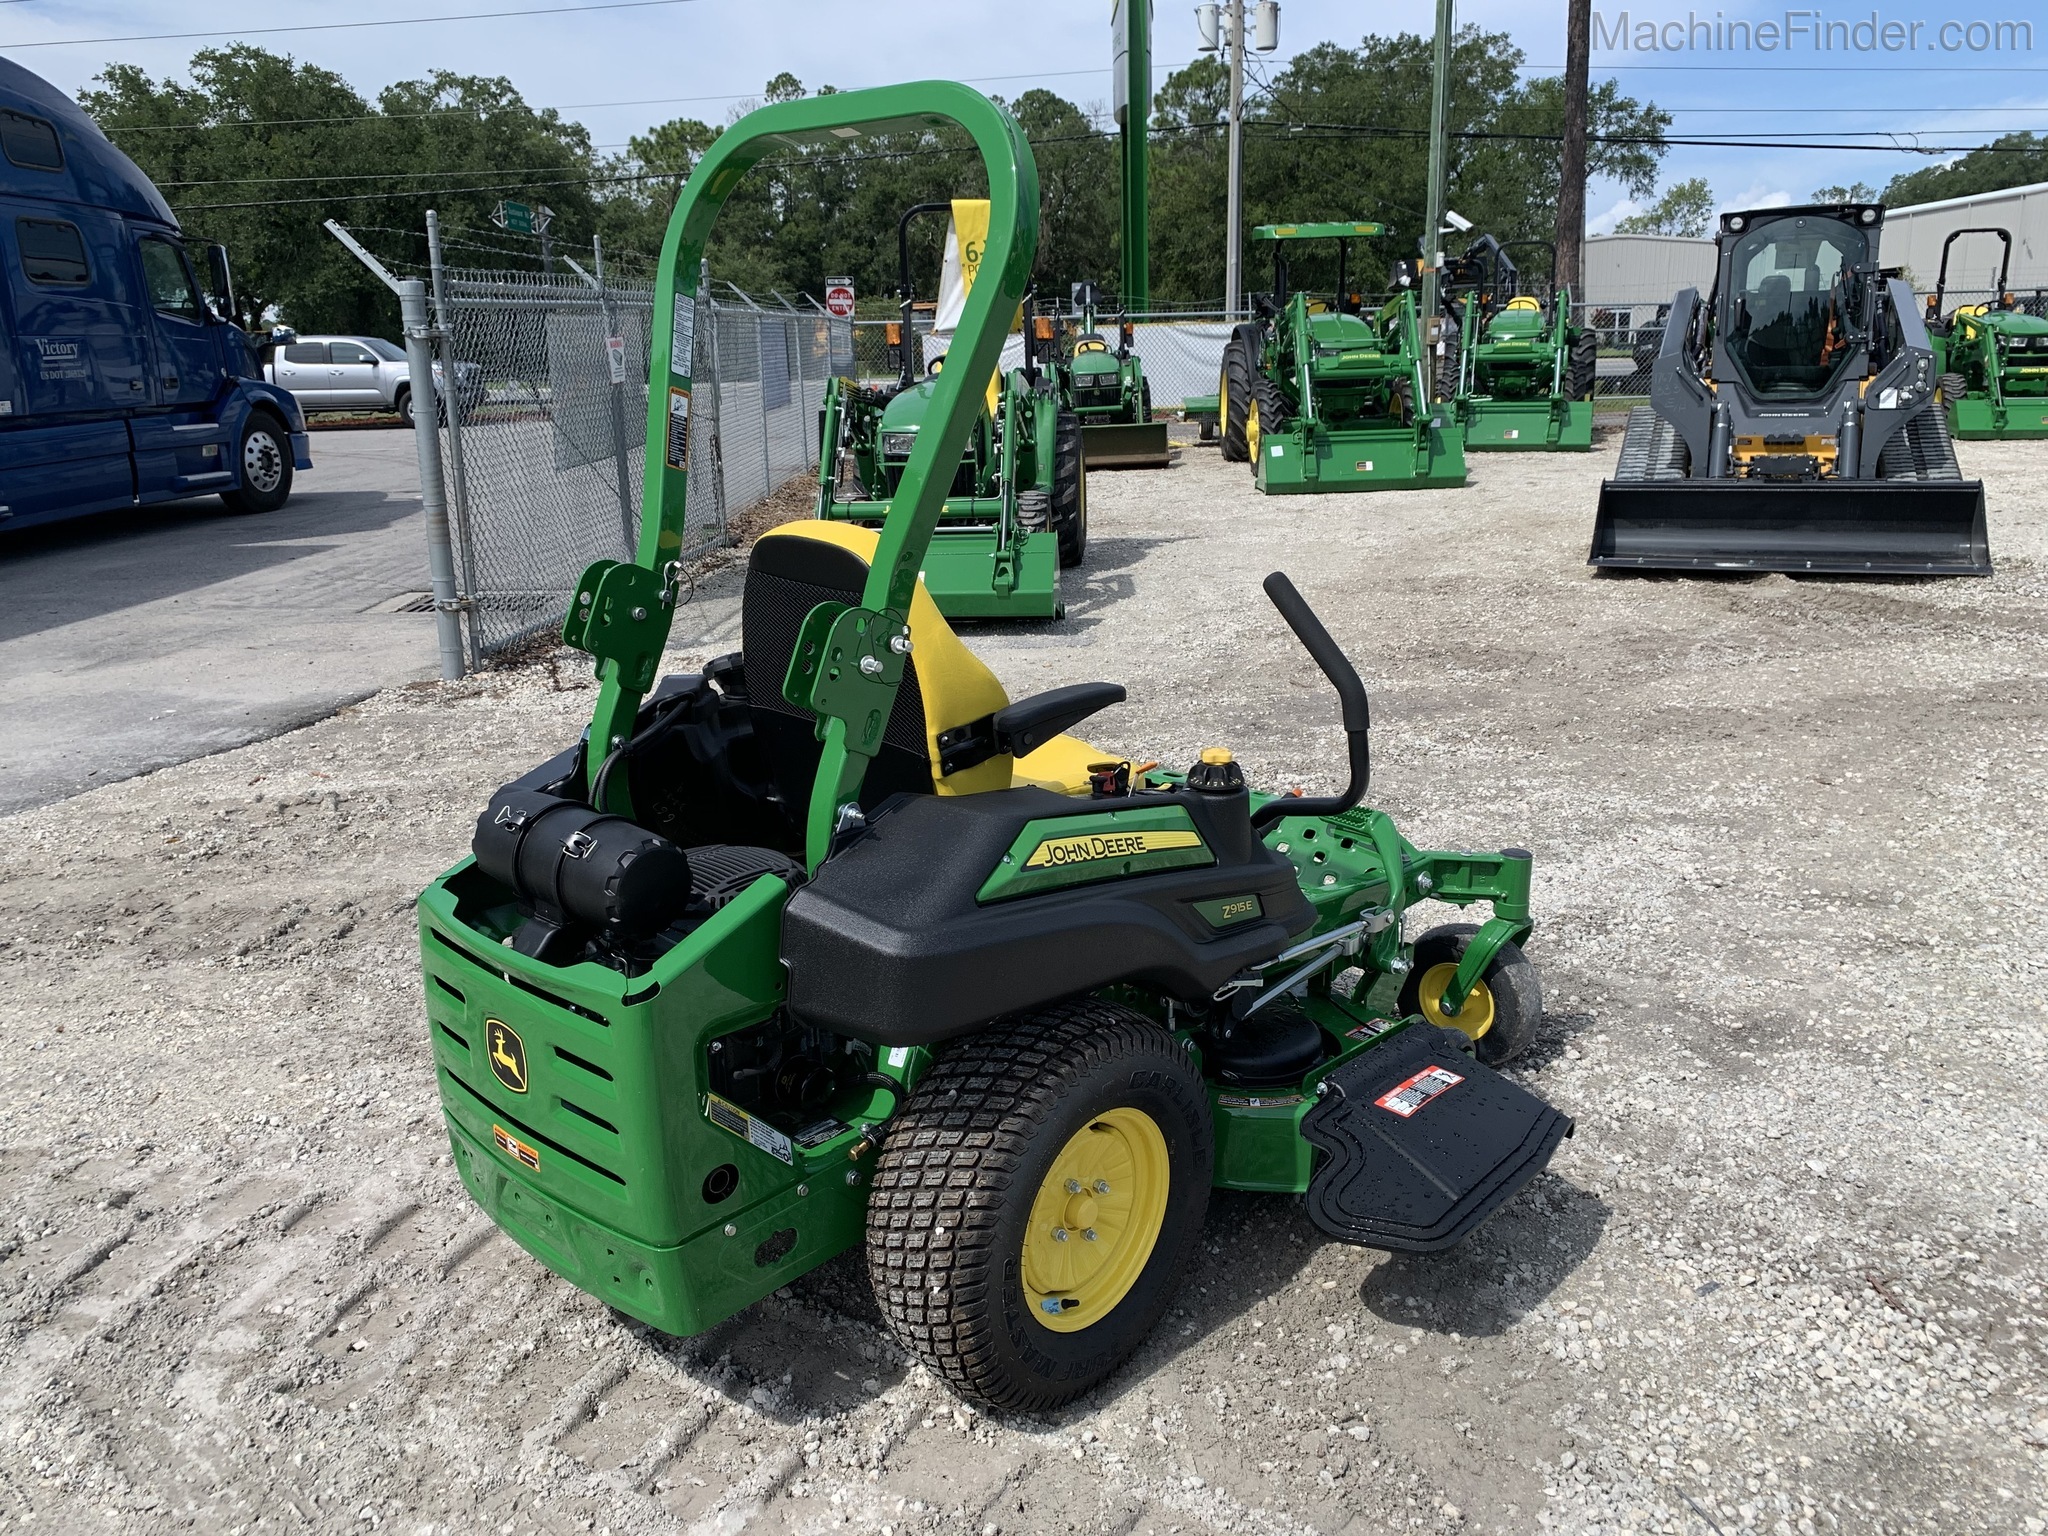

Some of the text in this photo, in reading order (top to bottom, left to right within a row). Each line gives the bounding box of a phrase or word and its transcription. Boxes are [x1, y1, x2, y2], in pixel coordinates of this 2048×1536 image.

[35, 338, 78, 359] Victory
[40, 371, 49, 380] US
[50, 370, 64, 379] DOT
[1045, 836, 1147, 865] JOHN DEERE
[1222, 900, 1253, 919] Z915E
